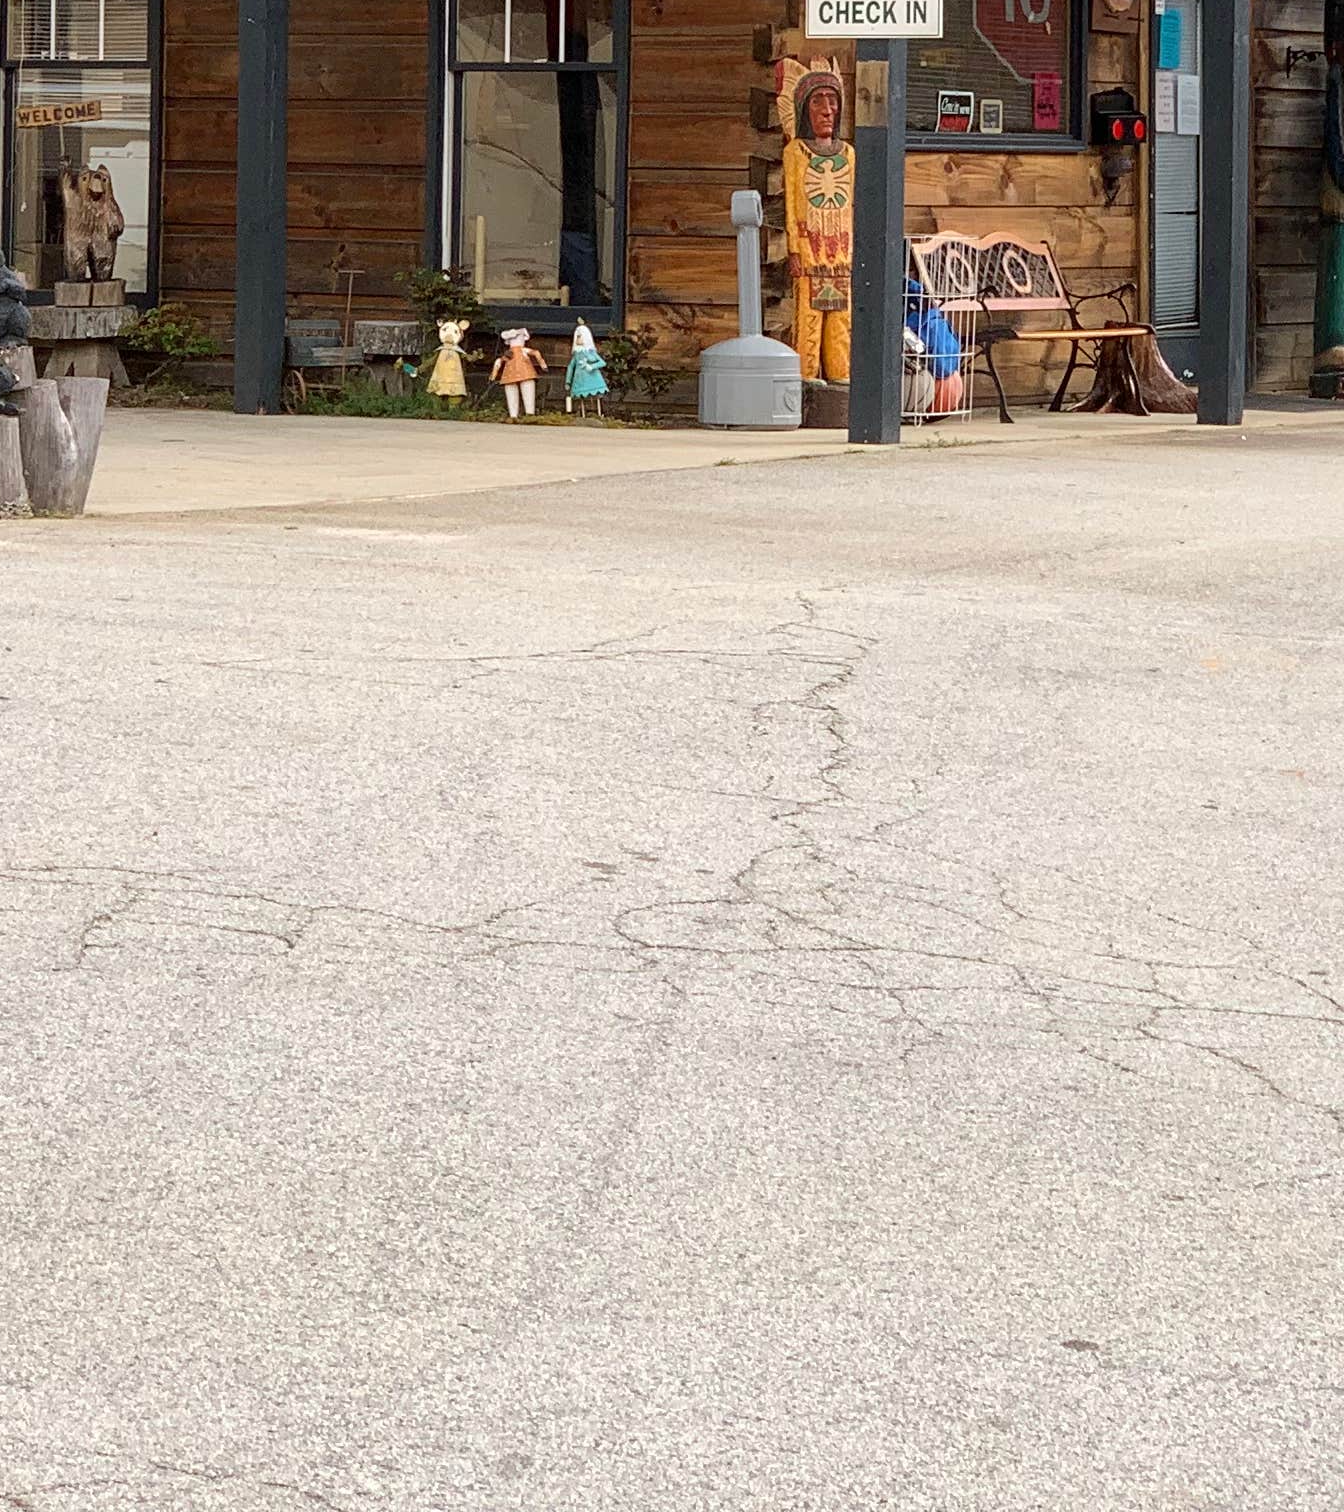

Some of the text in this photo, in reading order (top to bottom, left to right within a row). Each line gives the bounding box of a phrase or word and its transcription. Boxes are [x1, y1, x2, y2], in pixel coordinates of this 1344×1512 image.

[818, 0, 927, 24] CHECK IN
[18, 102, 96, 124] WELCOME
